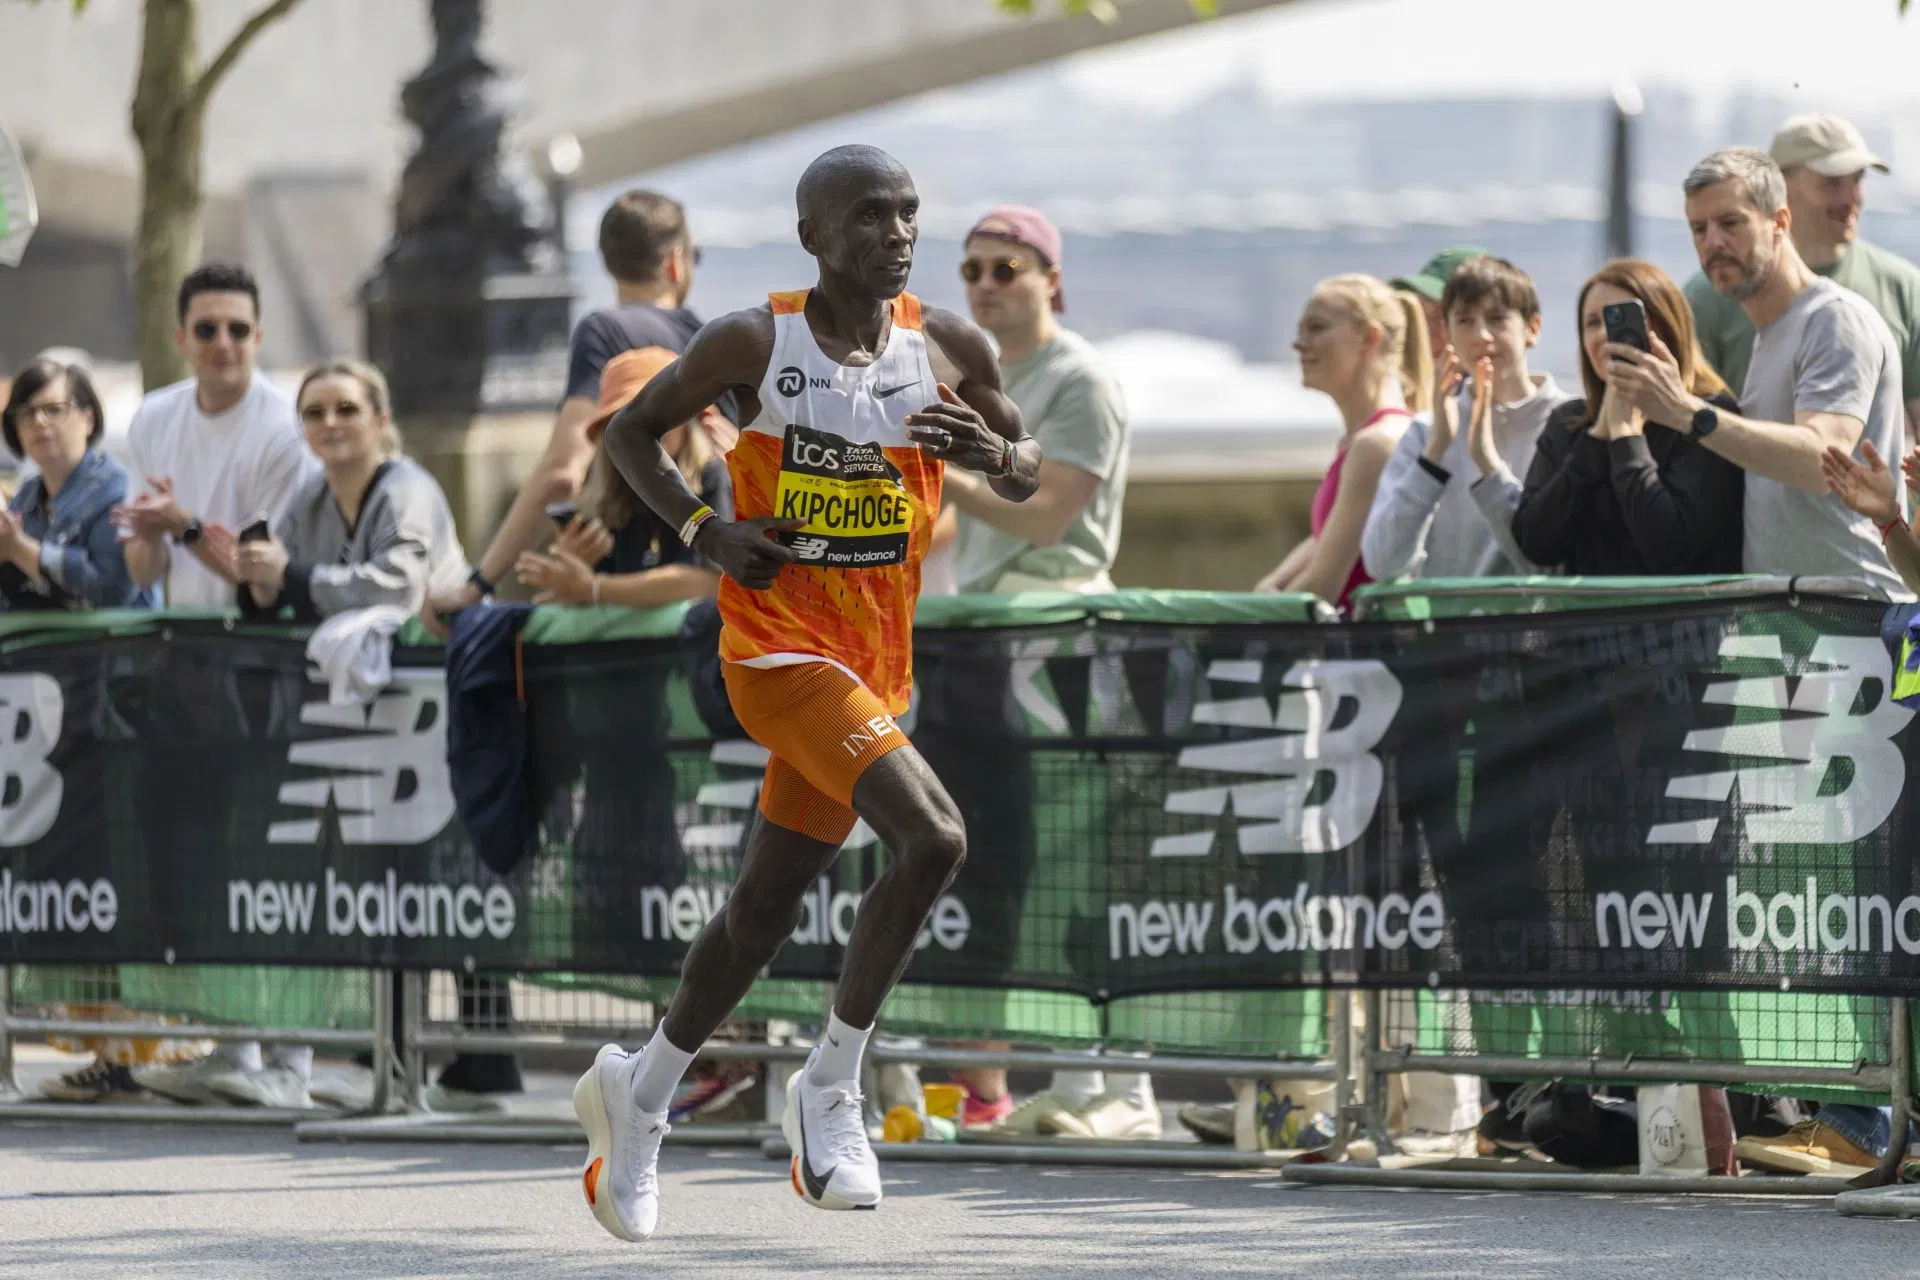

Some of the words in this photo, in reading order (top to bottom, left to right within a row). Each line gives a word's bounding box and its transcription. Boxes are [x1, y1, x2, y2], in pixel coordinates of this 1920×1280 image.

[809, 377, 831, 389] NN
[792, 433, 839, 470] tcs
[844, 463, 885, 473] SERVICES
[846, 446, 874, 455] TATA
[781, 488, 909, 529] KIPCHOGE
[827, 551, 852, 562] new
[853, 550, 896, 562] balance
[0, 868, 118, 933] lance
[228, 880, 317, 934] new
[326, 868, 516, 938] balance
[789, 876, 970, 950] alae
[1109, 901, 1214, 960] new
[1223, 882, 1444, 954] balance
[1595, 889, 1713, 950] new
[1727, 875, 1920, 955] balanc
